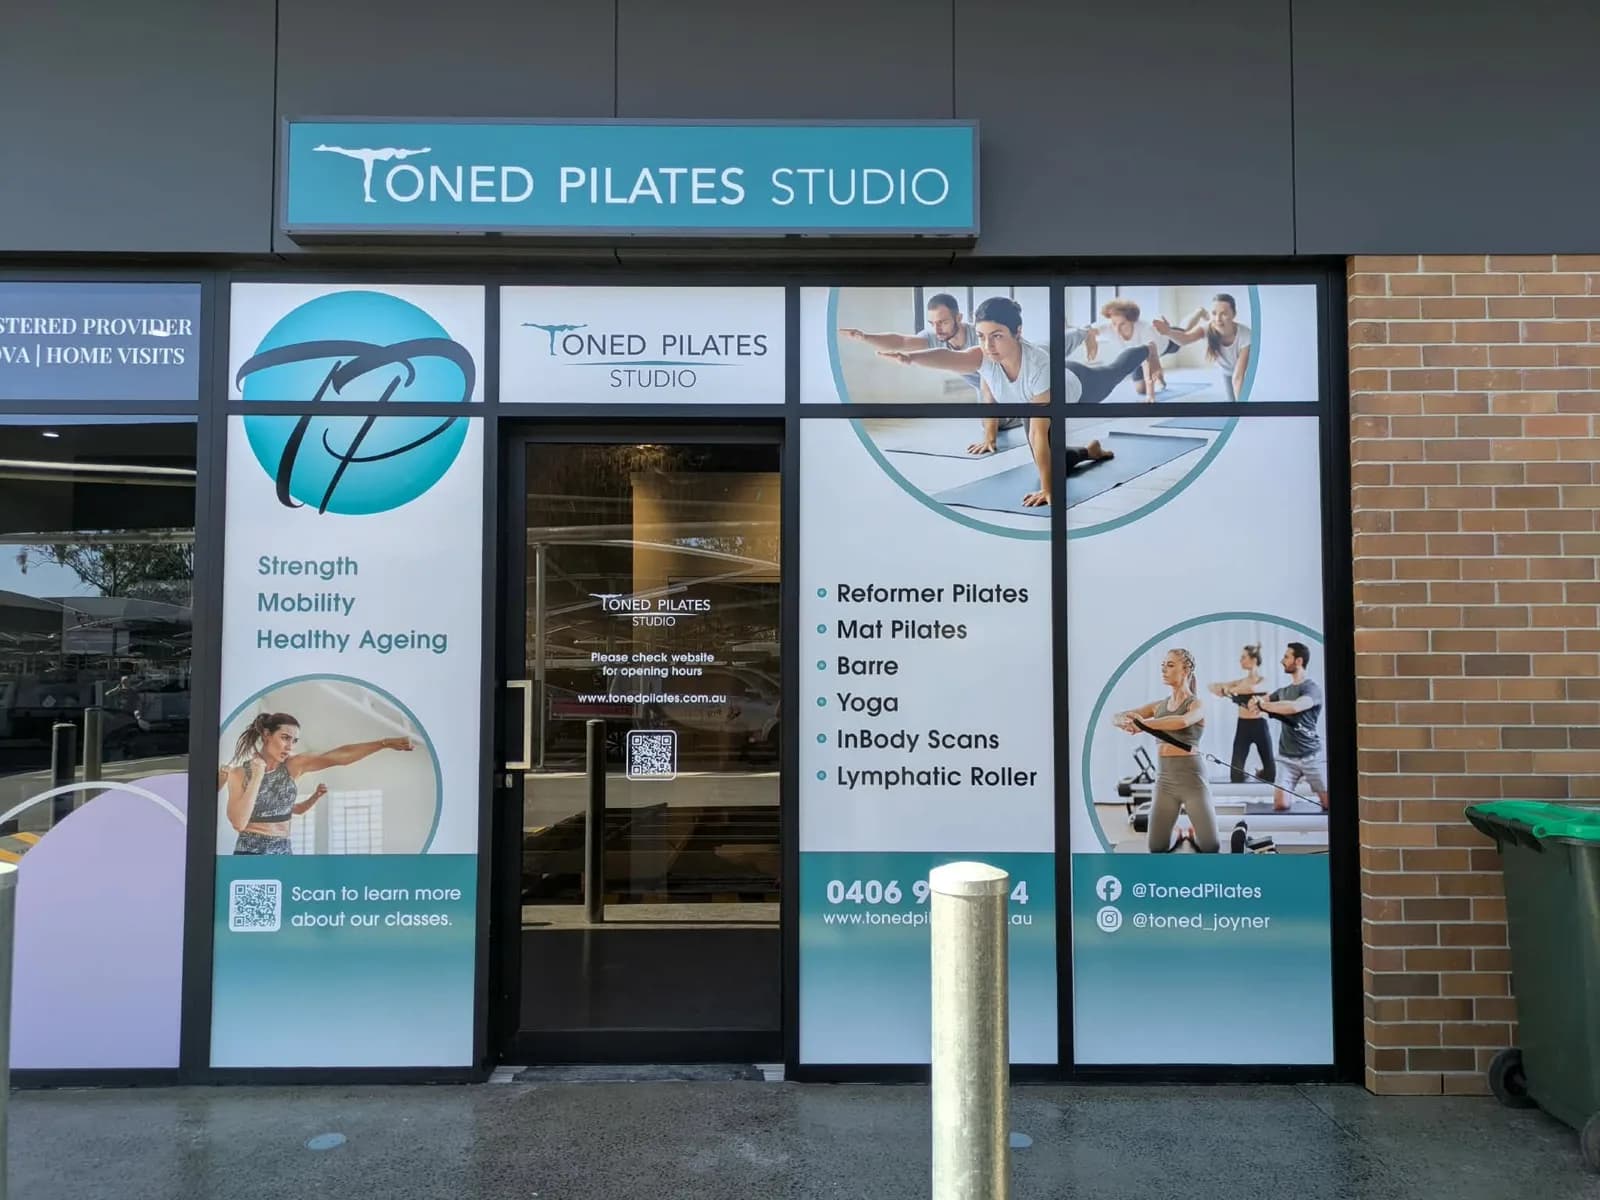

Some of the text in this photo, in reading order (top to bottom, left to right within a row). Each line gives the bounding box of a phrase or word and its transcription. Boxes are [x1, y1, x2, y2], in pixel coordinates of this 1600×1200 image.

[561, 167, 745, 206] PILATES
[771, 167, 949, 206] STUDIO
[84, 318, 192, 336] PROVIDER
[663, 334, 767, 356] PILATES
[0, 347, 185, 365] VA HOME VISITS
[610, 369, 697, 388] STUDIO
[258, 555, 359, 580] Strength
[837, 583, 1029, 603] Reformer Pilates
[257, 592, 356, 617] Mobility
[657, 599, 711, 611] PILATES
[632, 616, 676, 627] STUDIO
[837, 619, 967, 639] Mat Pilates
[257, 629, 448, 655] Healthy Ageing
[591, 652, 715, 663] Please check website
[837, 656, 899, 675] Barre
[602, 666, 703, 679] for opening hours
[577, 692, 727, 705] www.tonedpilates.com.au
[837, 692, 899, 717] Yoga
[837, 729, 1000, 753] InBody Scans
[838, 766, 1038, 790] Lymphatic Roller
[291, 885, 462, 901] Scan to learn more
[826, 880, 903, 905] 0406
[1132, 882, 1262, 898] @TonedPilates
[291, 911, 453, 927] about our classes.
[1132, 912, 1271, 932] @toned_joyner
